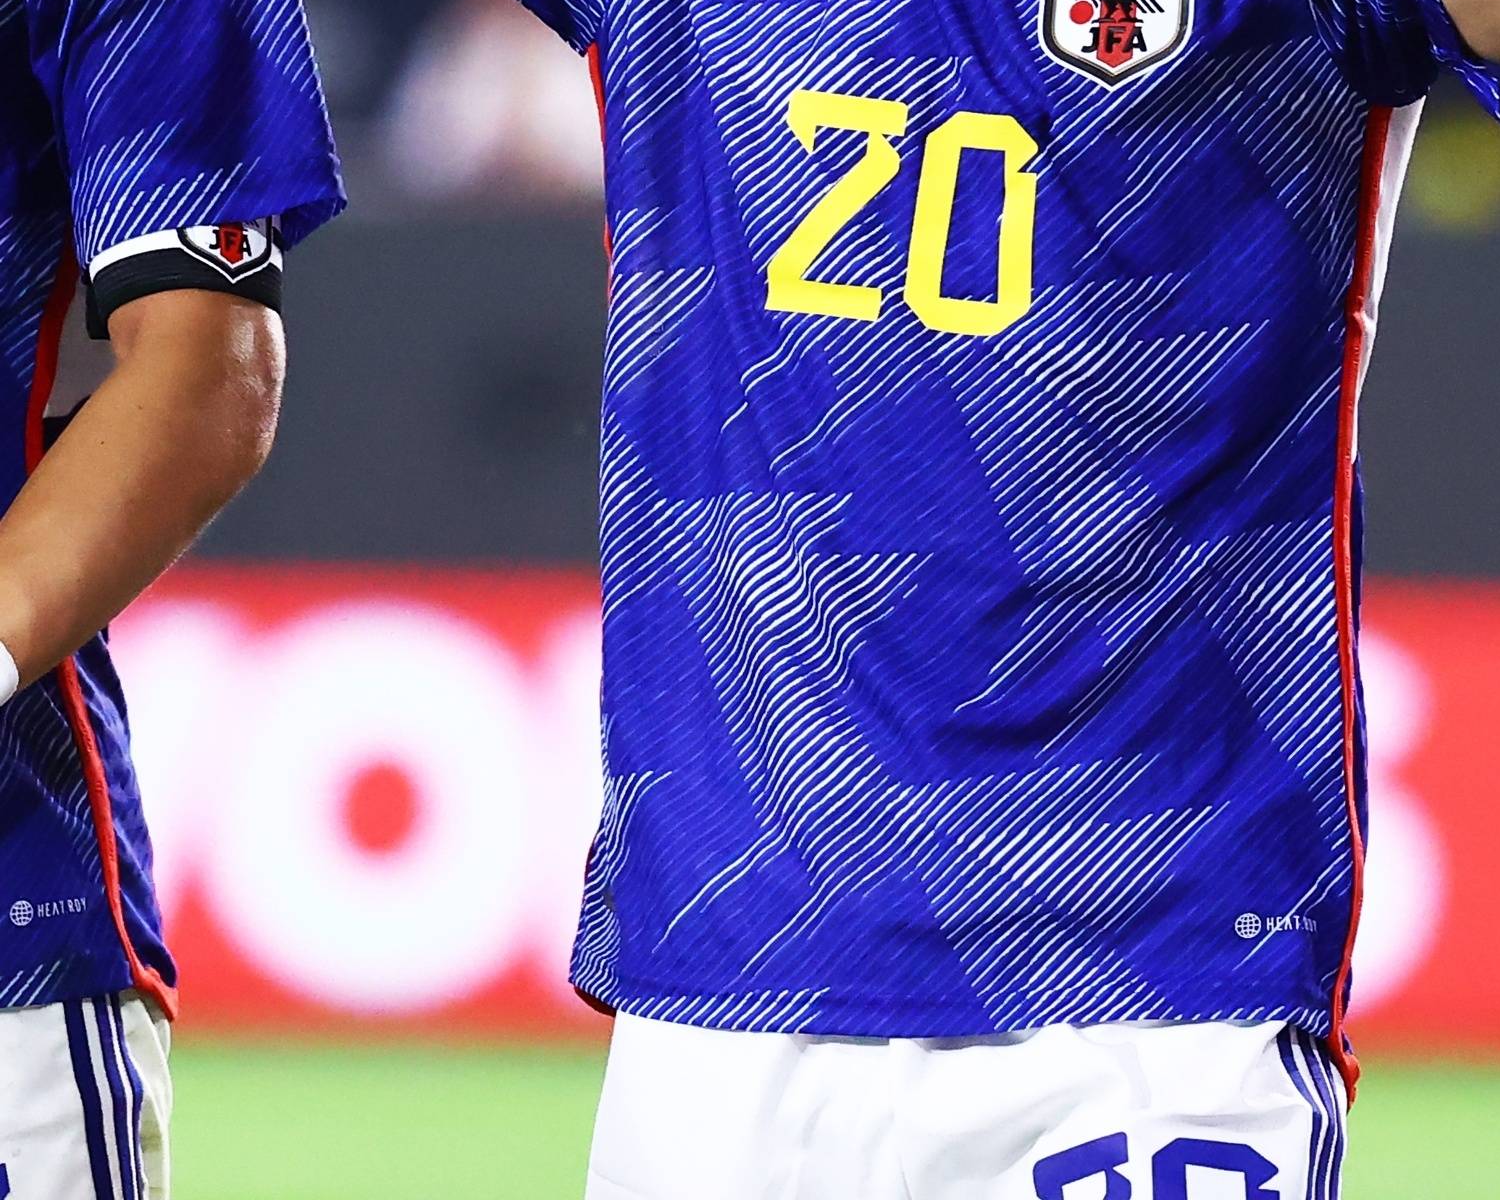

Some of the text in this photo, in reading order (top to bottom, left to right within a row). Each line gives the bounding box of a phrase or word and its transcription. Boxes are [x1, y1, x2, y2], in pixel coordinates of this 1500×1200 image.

[1081, 26, 1147, 53] JFA
[765, 88, 1039, 337] 20
[208, 228, 253, 257] JFA
